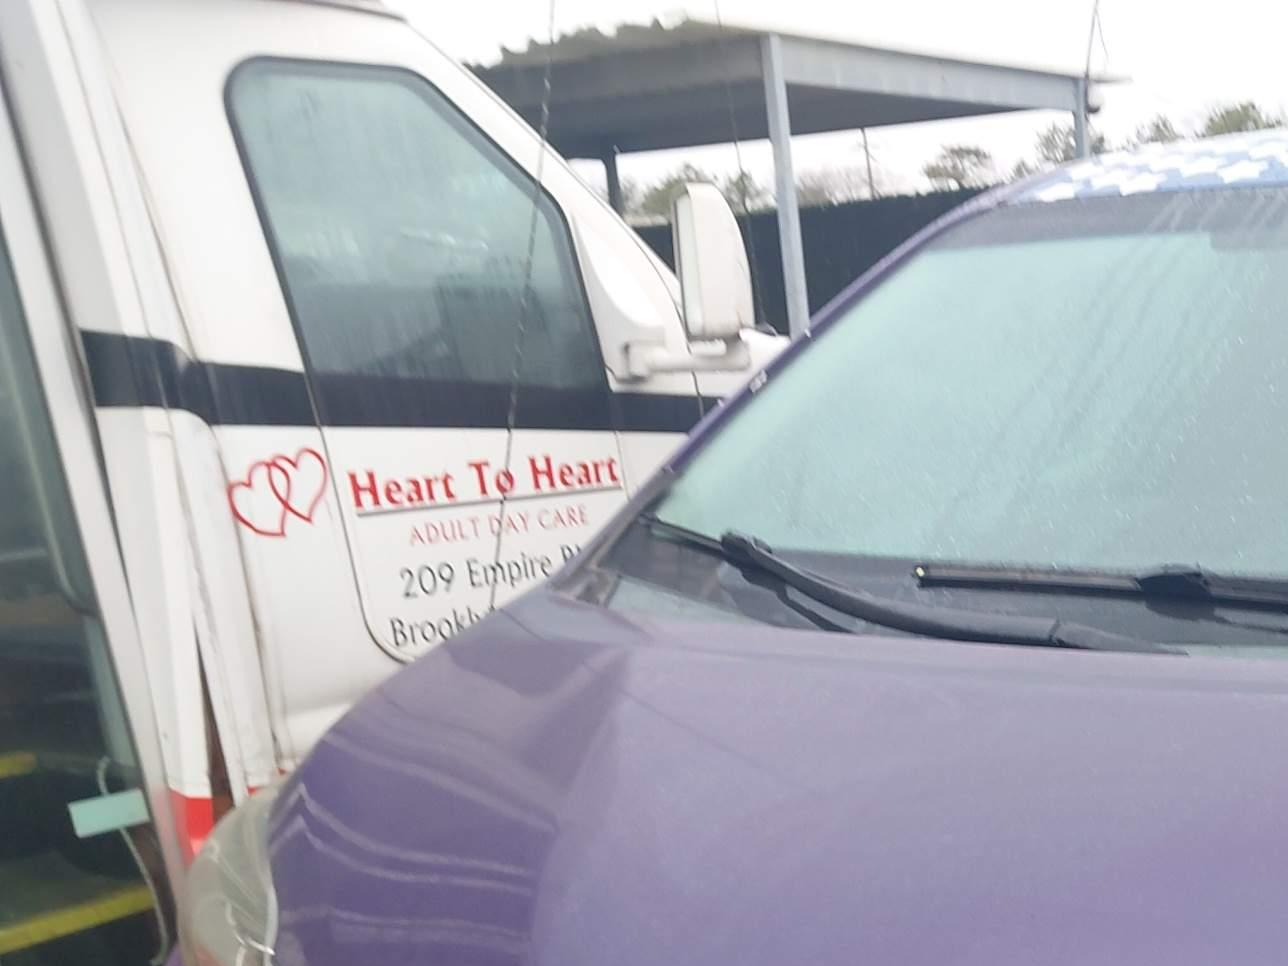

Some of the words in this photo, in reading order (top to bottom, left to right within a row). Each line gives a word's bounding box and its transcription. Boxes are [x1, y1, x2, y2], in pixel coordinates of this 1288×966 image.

[347, 467, 457, 510] Heart
[468, 458, 516, 499] To
[528, 453, 621, 492] Heart
[409, 518, 481, 547] ADULT
[487, 510, 532, 537] DAY
[537, 504, 590, 530] CARE
[399, 560, 455, 600] 209
[467, 551, 553, 589] Empire
